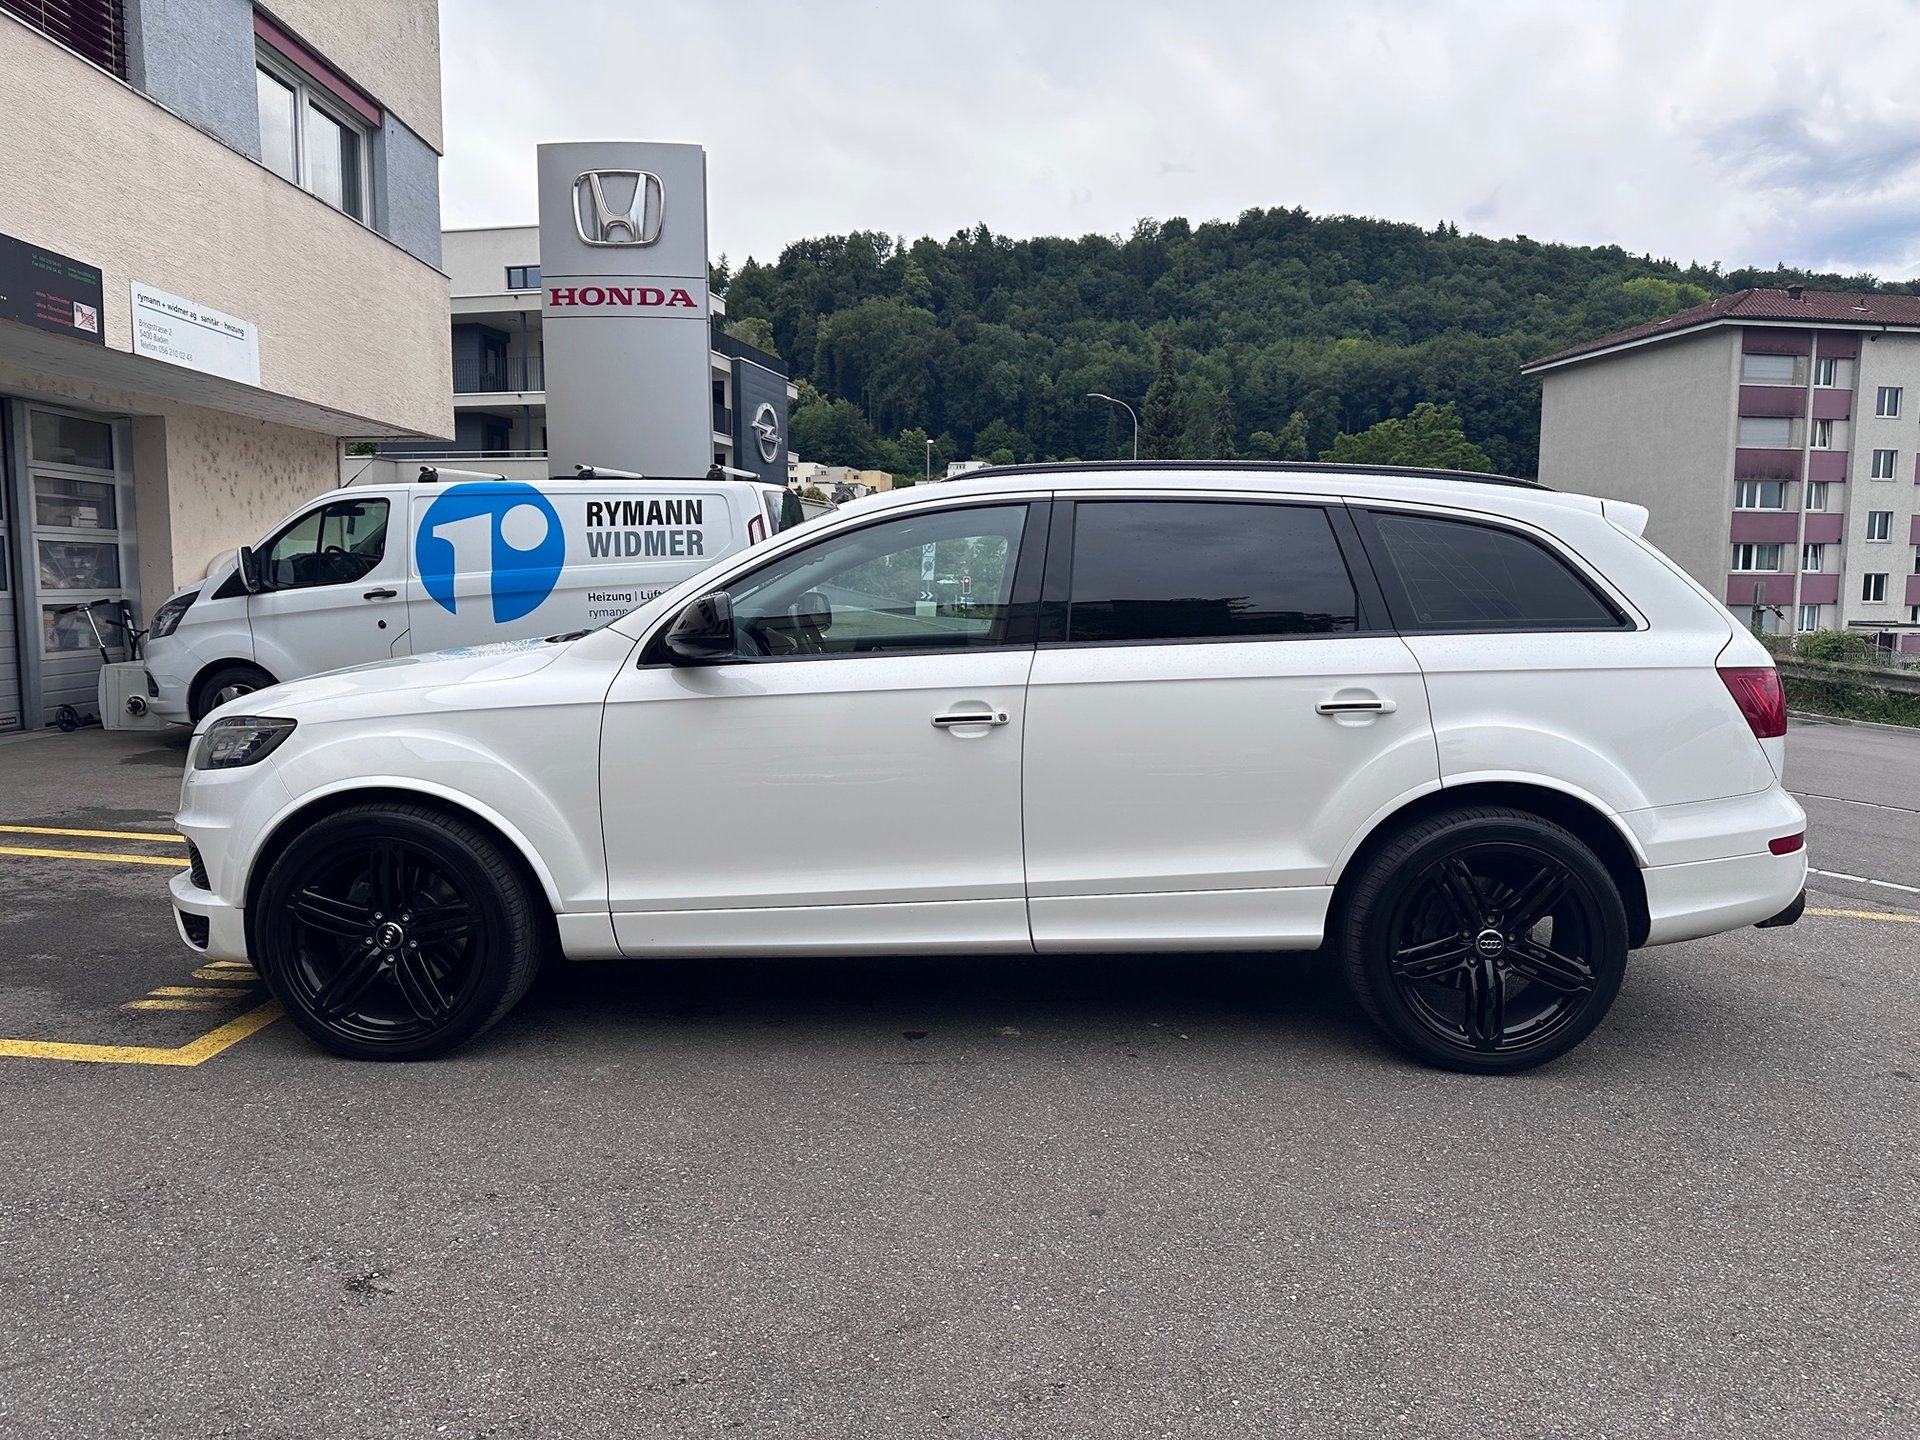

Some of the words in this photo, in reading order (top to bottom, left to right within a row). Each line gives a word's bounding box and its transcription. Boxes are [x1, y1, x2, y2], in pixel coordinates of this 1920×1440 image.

[549, 287, 698, 307] HONDA
[137, 293, 161, 306] rymann
[167, 303, 189, 316] widmer
[190, 312, 197, 321] ag
[224, 322, 245, 337] heizung
[139, 329, 153, 340] 5400
[153, 333, 169, 345] Baden
[168, 328, 173, 337] 2
[140, 339, 158, 352] Telefon
[158, 344, 168, 355] 056
[169, 347, 178, 358] 210
[179, 350, 186, 360] 02
[186, 353, 193, 362] 43
[586, 499, 703, 527] RYMANN
[586, 529, 704, 558] WIDMER
[588, 591, 632, 603] Heizung
